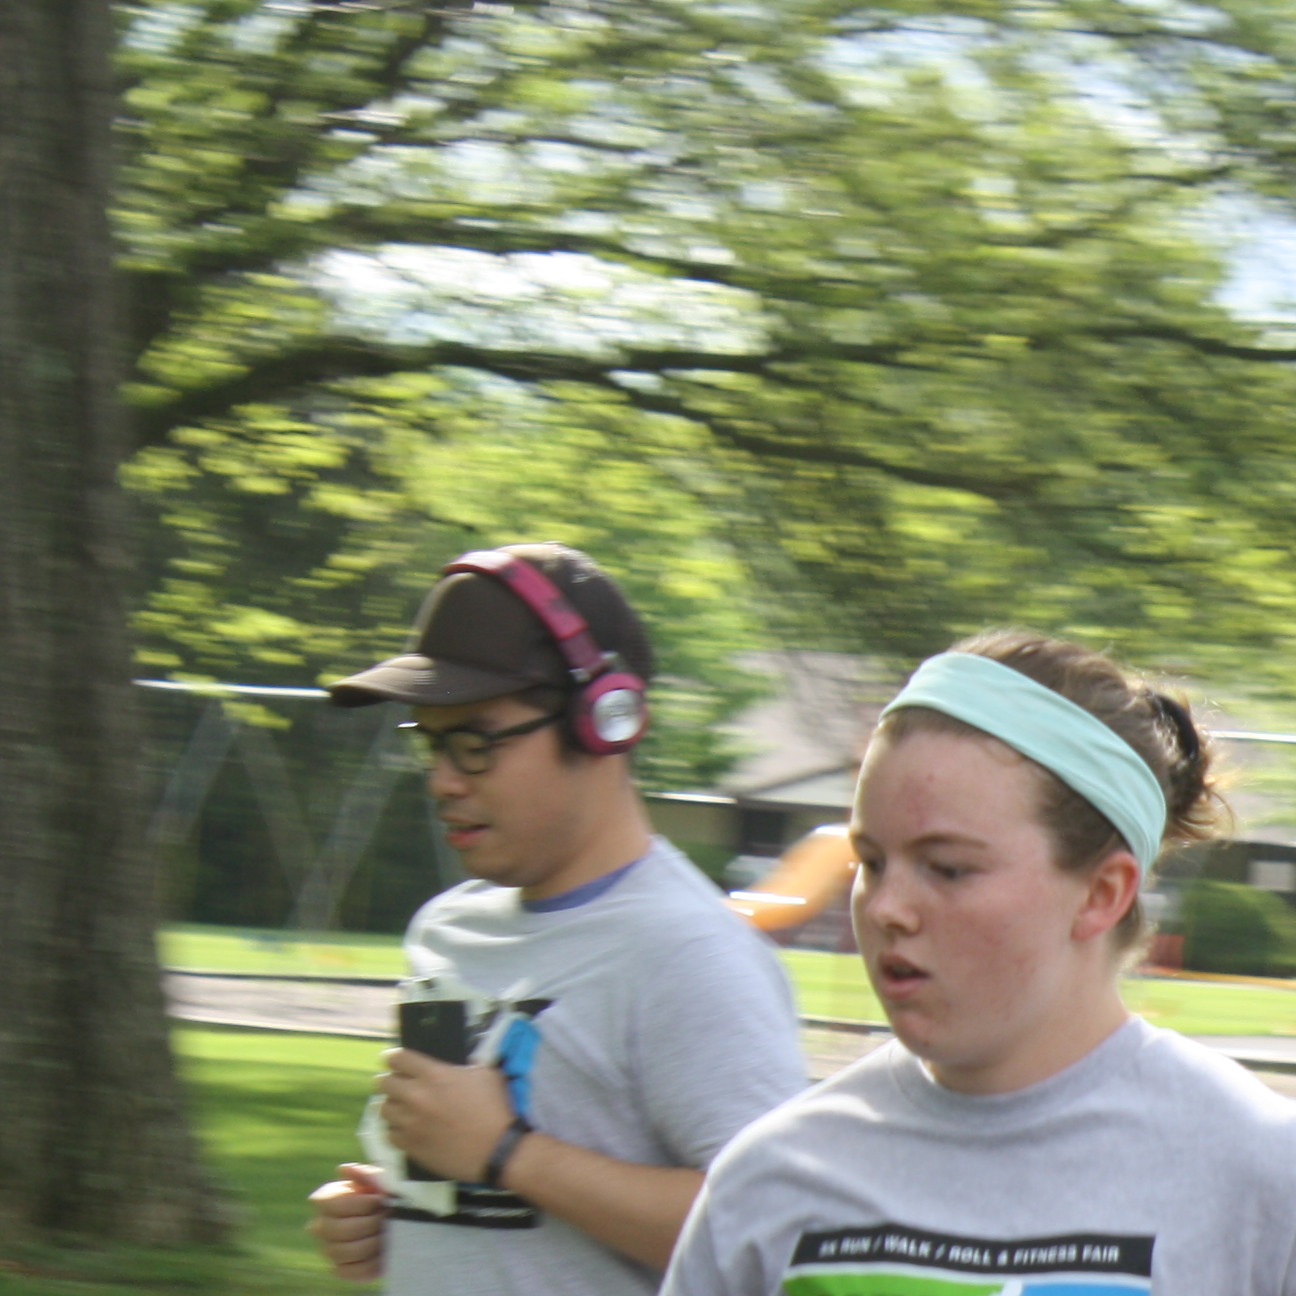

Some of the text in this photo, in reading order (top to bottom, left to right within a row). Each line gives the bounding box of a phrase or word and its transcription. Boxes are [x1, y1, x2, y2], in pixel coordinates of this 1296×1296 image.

[840, 1236, 871, 1255] RUN
[884, 1233, 930, 1259] WALK
[949, 1244, 991, 1267] ROLL
[1013, 1244, 1076, 1266] FITNESS
[1082, 1244, 1119, 1264] FAIR
